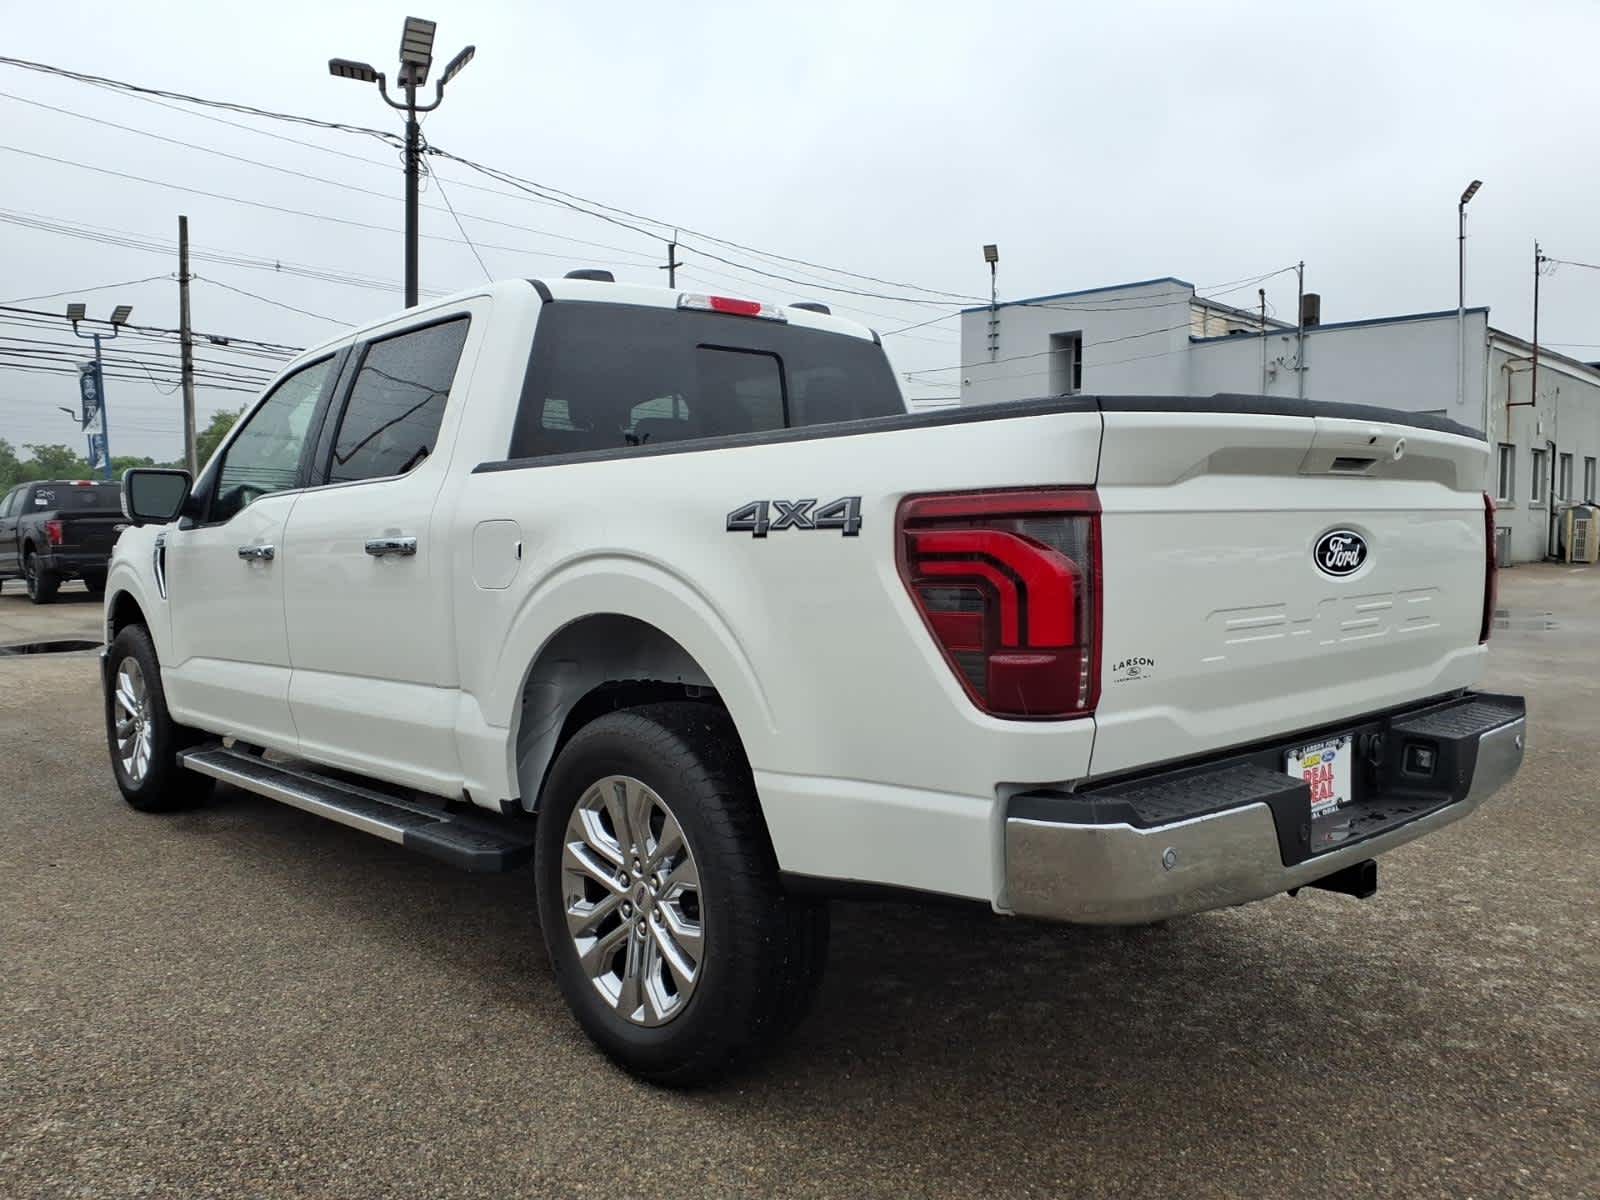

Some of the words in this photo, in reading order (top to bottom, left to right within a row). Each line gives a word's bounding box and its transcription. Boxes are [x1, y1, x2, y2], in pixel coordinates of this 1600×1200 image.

[1326, 536, 1361, 567] Ford
[1112, 657, 1154, 672] LARSON
[1311, 780, 1334, 803] EAL
